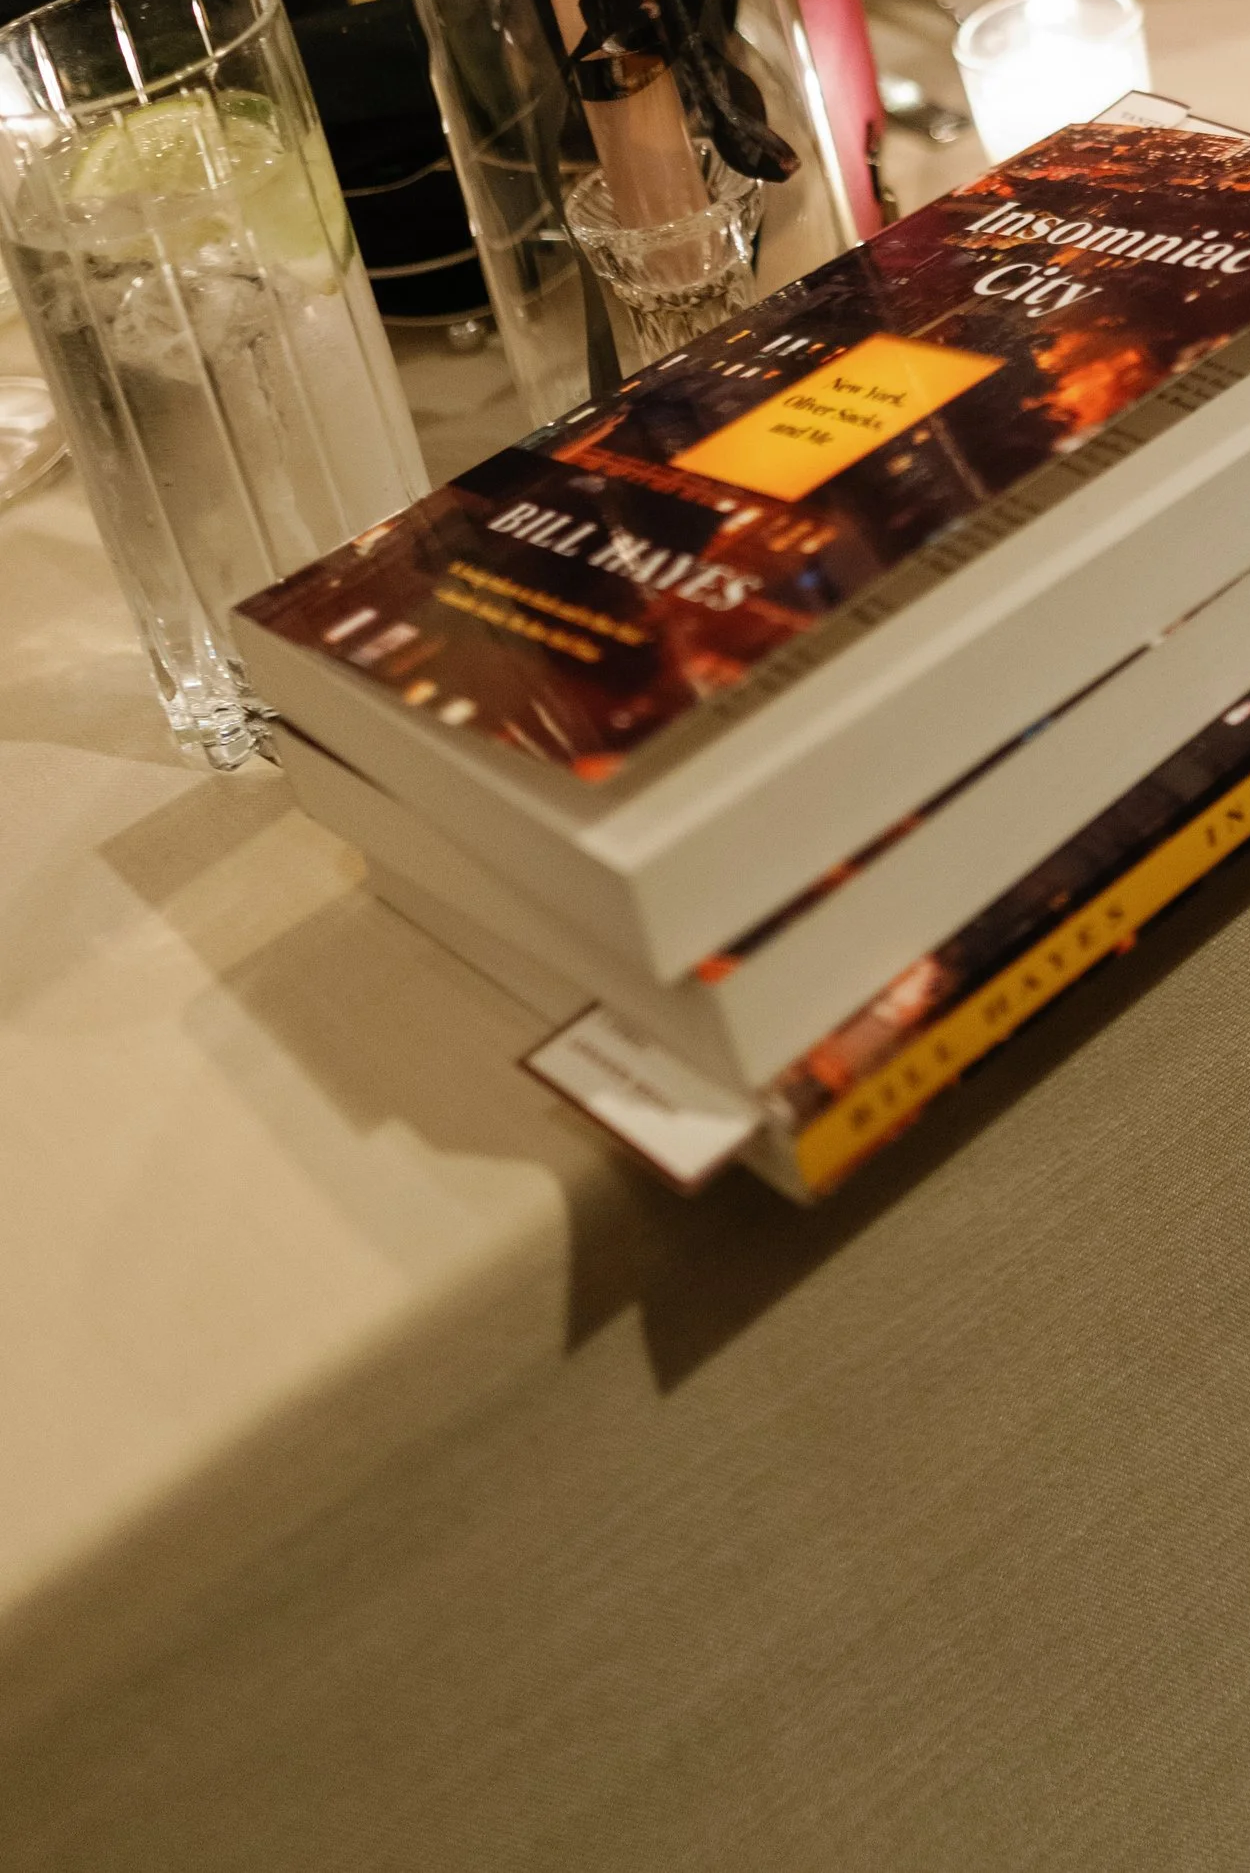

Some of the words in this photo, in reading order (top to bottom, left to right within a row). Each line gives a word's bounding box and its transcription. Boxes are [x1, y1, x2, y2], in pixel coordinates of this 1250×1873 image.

[973, 262, 1104, 318] City
[782, 394, 836, 416] Oliver
[487, 501, 599, 558] BILL
[587, 534, 765, 612] HAYES
[981, 902, 1126, 1027] HAYES
